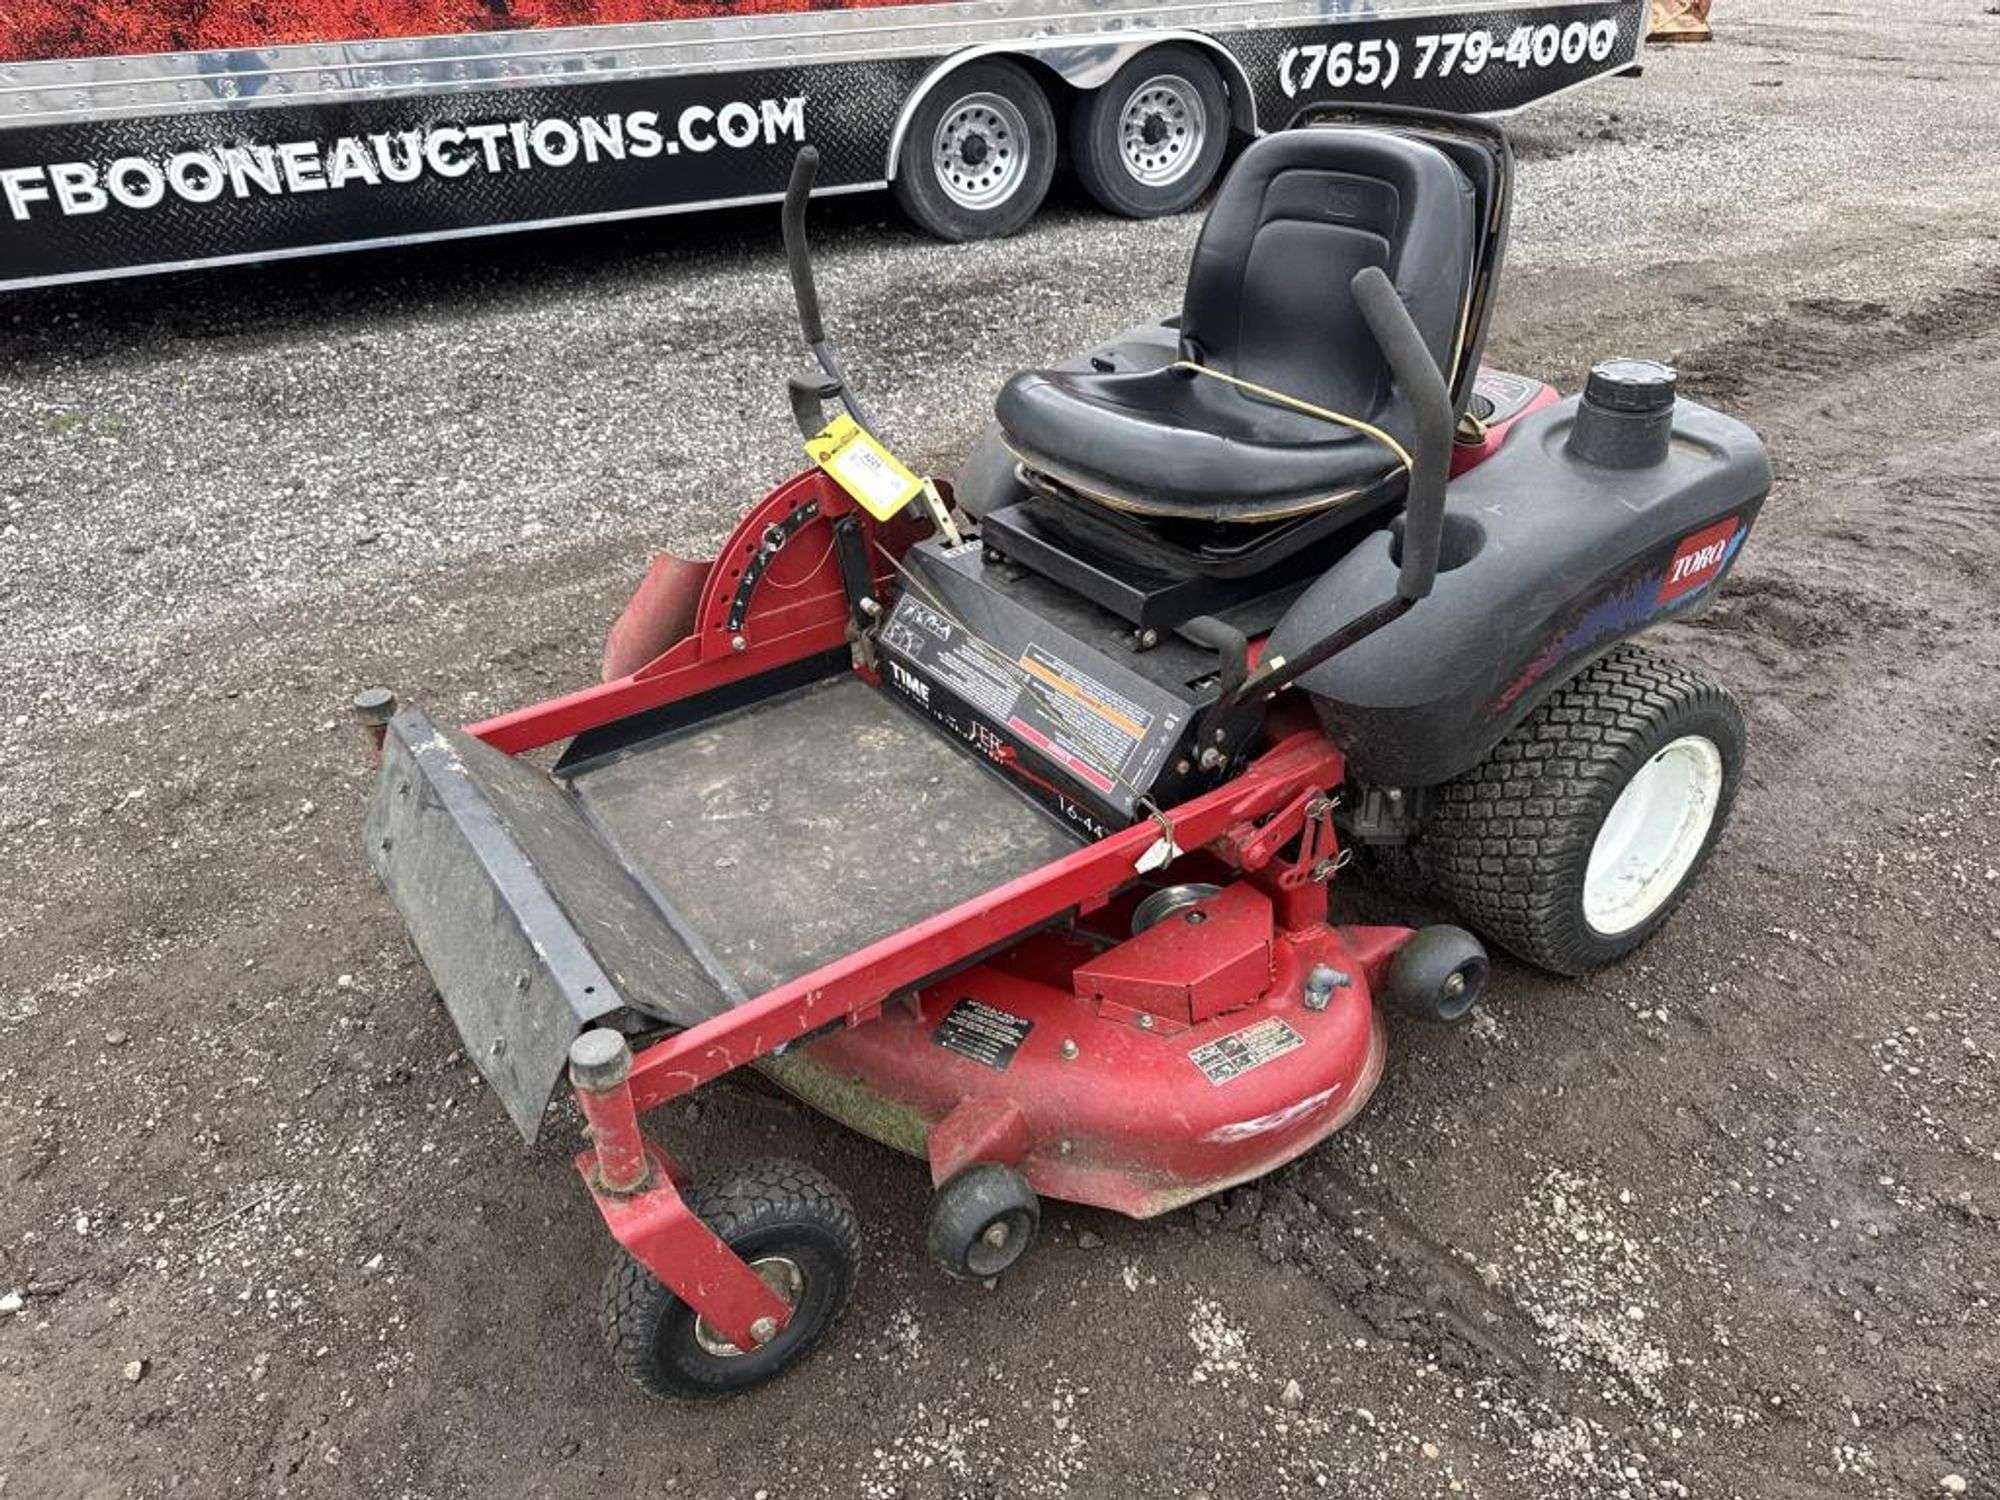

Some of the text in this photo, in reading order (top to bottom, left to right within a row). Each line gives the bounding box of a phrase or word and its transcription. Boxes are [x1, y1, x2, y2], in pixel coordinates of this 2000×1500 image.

[1279, 19, 1617, 98] (765) 779-4000
[0, 97, 807, 220] FBOONEAUCTIONS.COM
[1670, 539, 1726, 584] TORO
[889, 660, 931, 703] TIME
